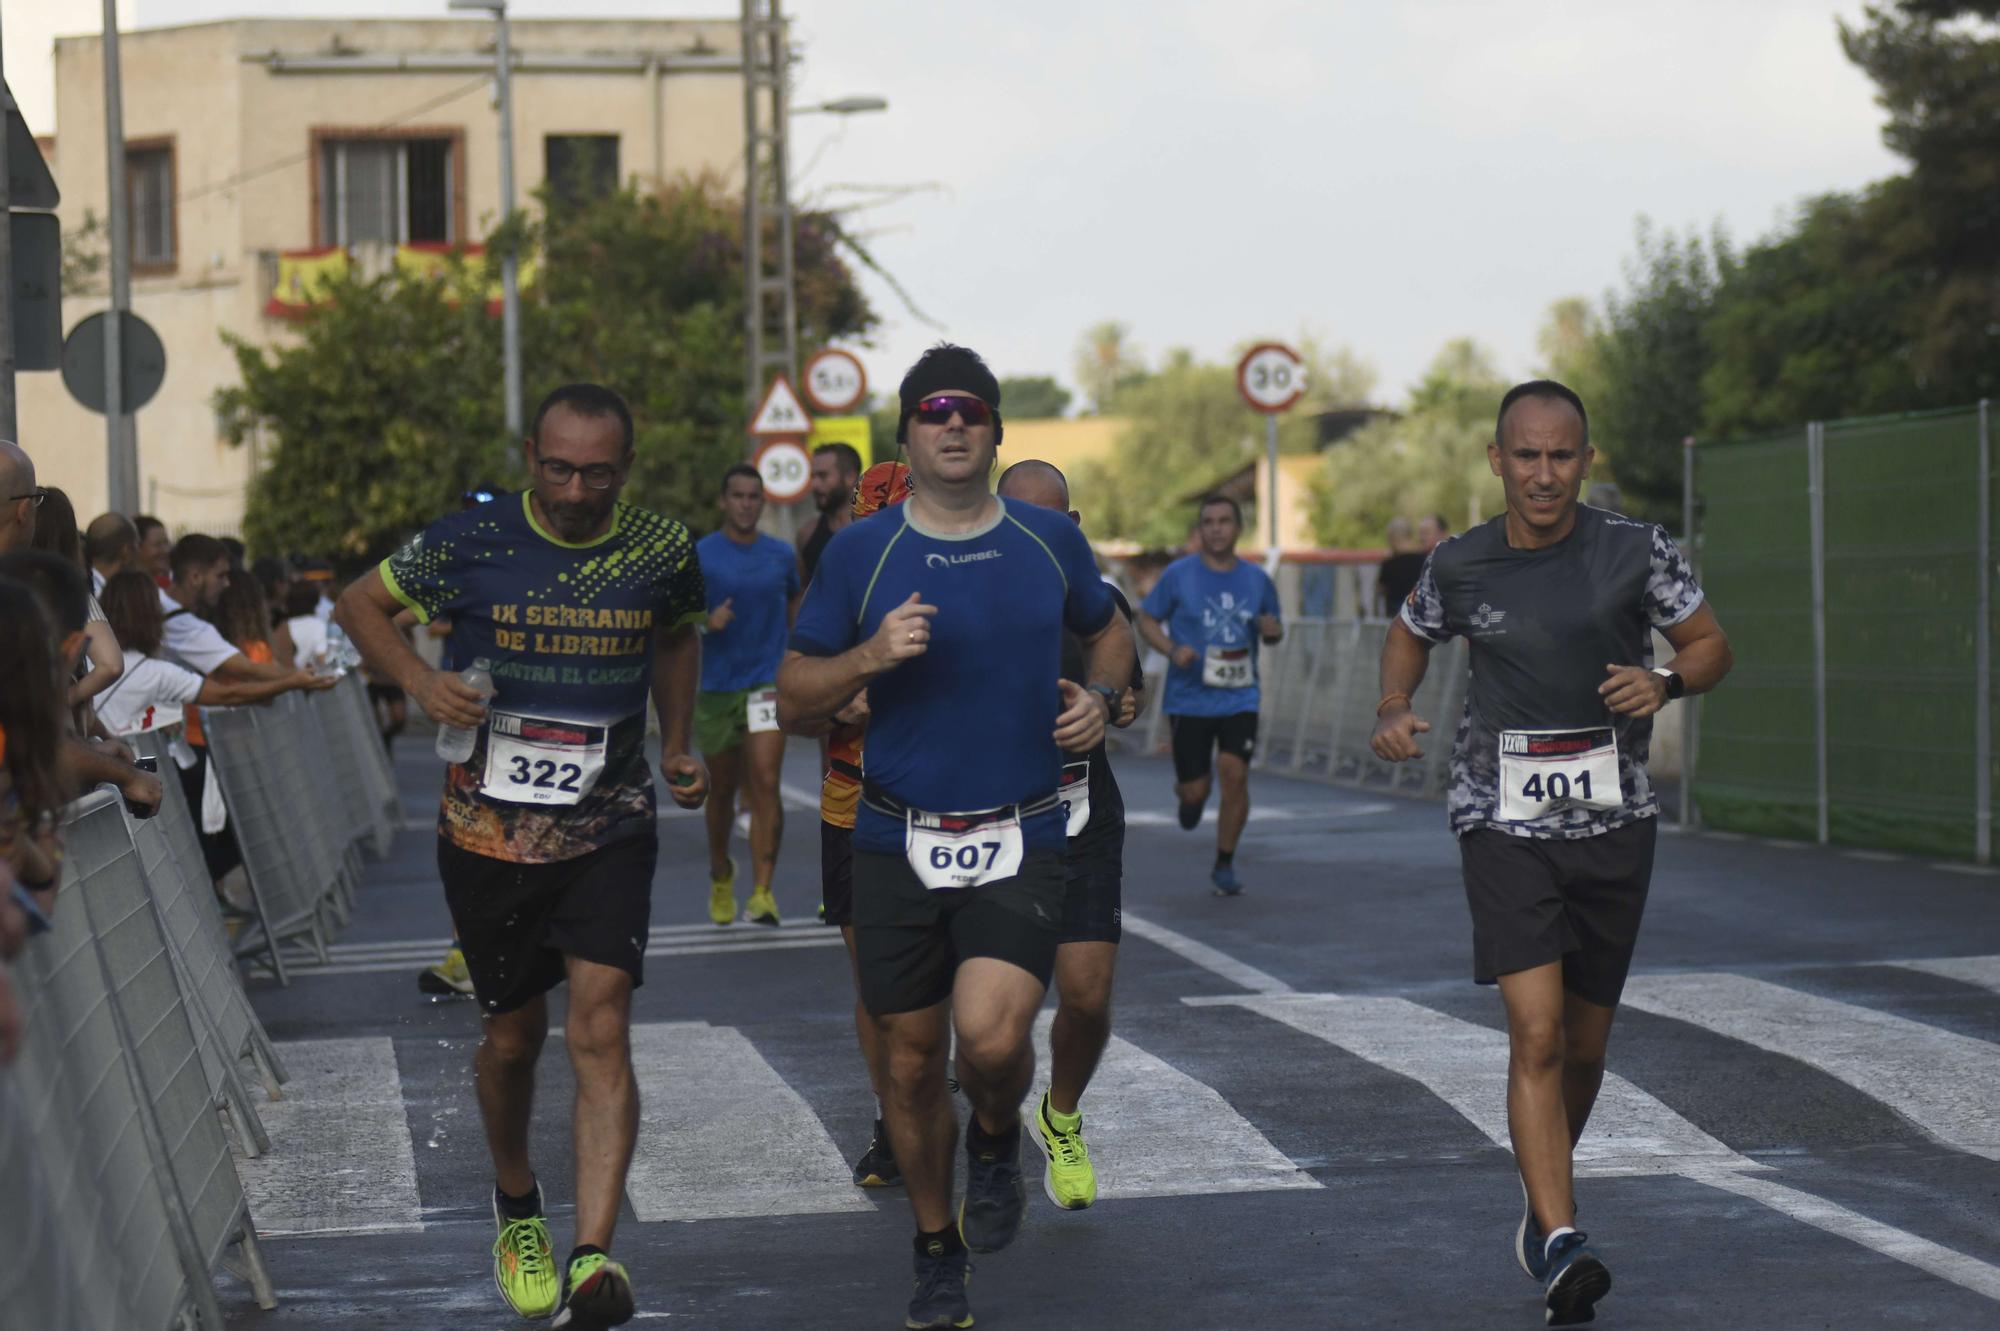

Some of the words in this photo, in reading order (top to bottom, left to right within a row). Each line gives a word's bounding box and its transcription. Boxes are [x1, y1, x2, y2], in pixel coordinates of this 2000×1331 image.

[1252, 364, 1291, 389] 30
[767, 458, 802, 482] 30
[950, 550, 1002, 564] LURBEL
[492, 604, 518, 624] IX
[526, 605, 652, 629] SERRANIA
[496, 629, 526, 651] DE
[534, 633, 646, 656] LIBRILLA
[561, 667, 583, 685] EL
[1503, 734, 1528, 753] XXVIII
[509, 756, 582, 793] 322
[1522, 769, 1592, 802] 401
[930, 842, 1001, 871] 607
